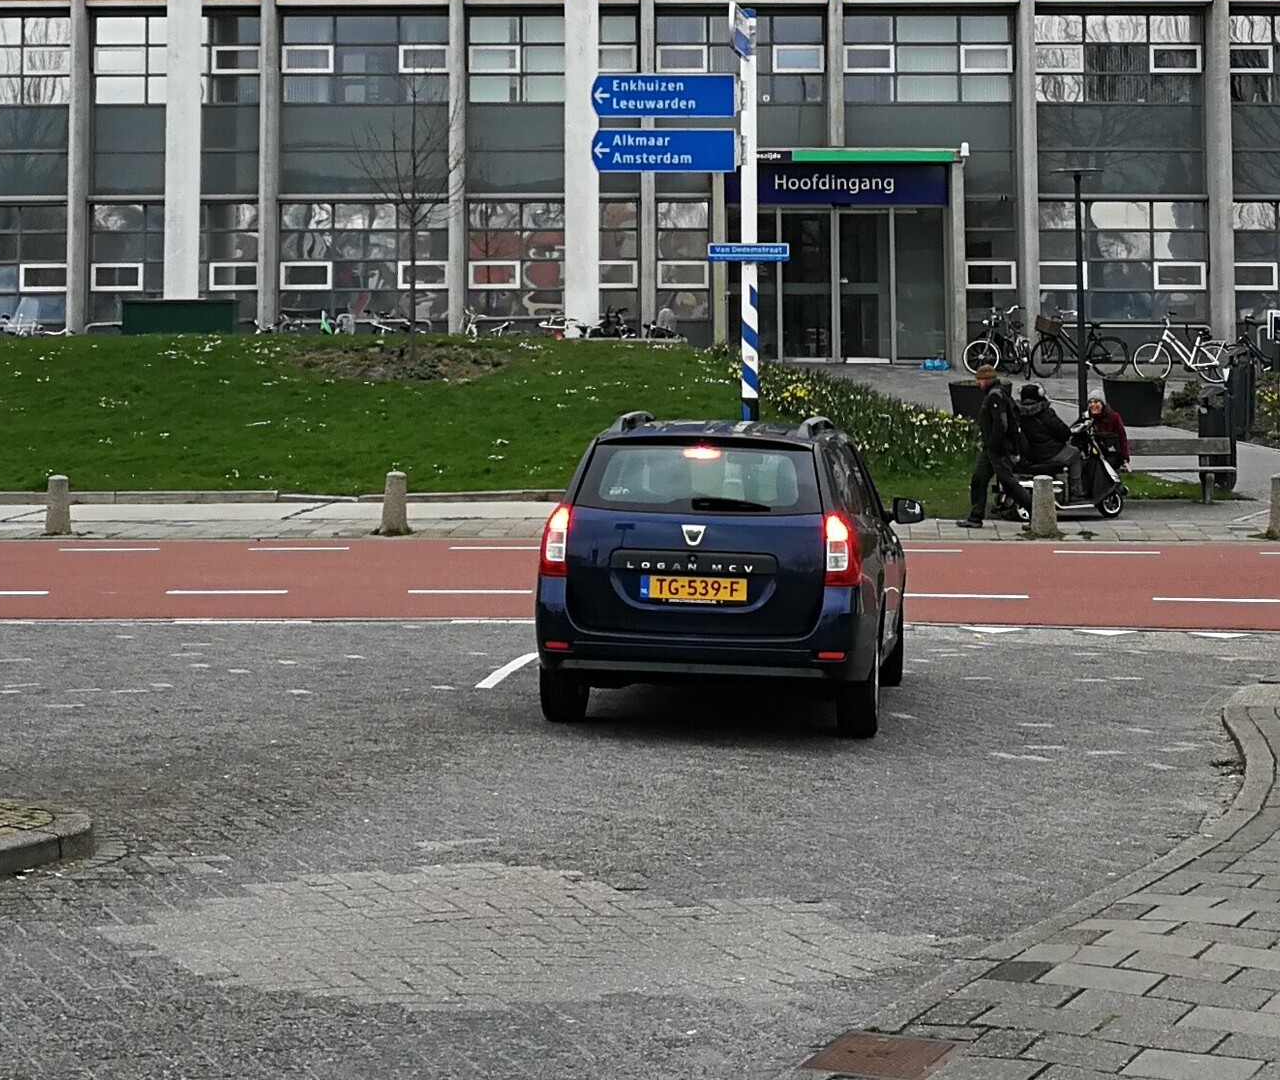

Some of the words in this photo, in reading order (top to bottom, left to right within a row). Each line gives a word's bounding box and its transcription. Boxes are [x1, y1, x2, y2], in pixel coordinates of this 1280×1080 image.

[612, 79, 685, 92] Enkhuizen
[612, 97, 697, 110] Leeuwarden
[612, 133, 671, 147] Alkmaar
[612, 152, 693, 164] Amsterdam
[773, 173, 895, 195] Hoofdingang
[714, 246, 731, 254] Van
[626, 561, 698, 572] LOGAN
[711, 564, 754, 573] MCV
[655, 577, 741, 598] TG-539-F
